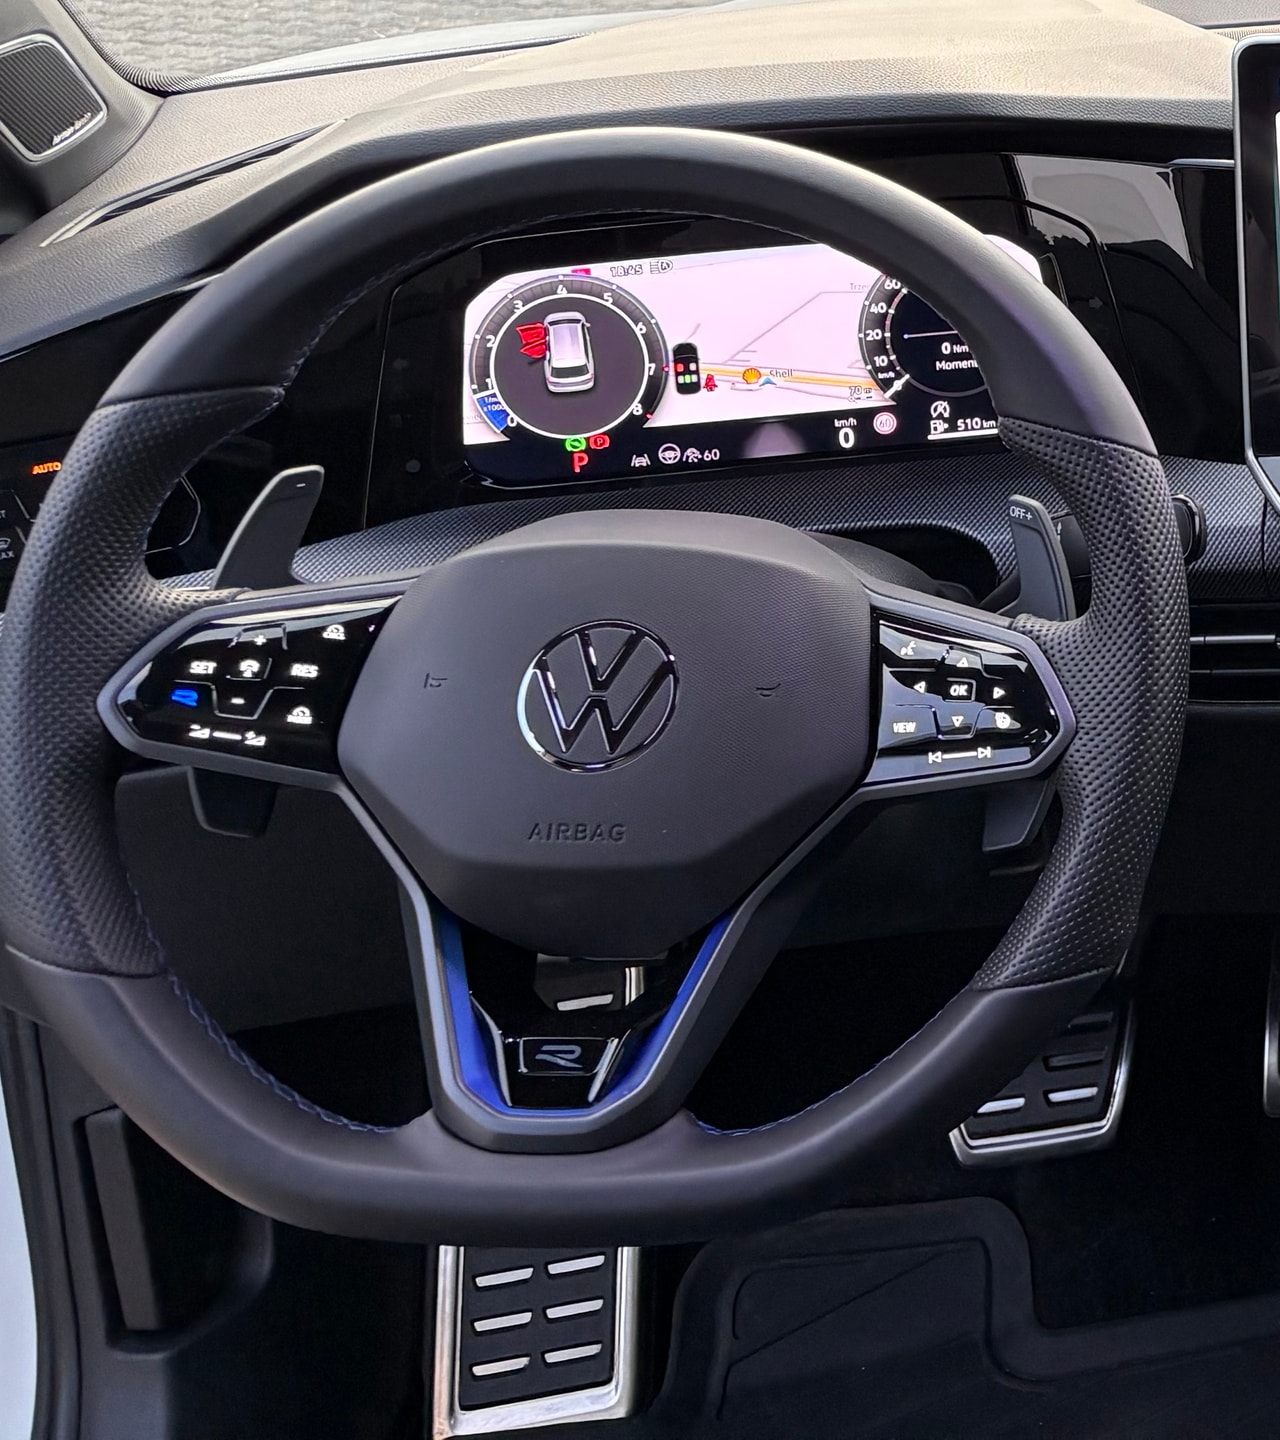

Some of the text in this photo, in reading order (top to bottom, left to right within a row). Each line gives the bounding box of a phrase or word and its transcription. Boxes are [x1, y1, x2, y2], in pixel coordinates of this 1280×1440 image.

[610, 263, 643, 277] 18:45
[557, 284, 568, 296] 4
[603, 292, 614, 304] 5
[513, 299, 524, 312] 3
[870, 302, 887, 314] 40
[636, 322, 647, 334] 6
[866, 328, 882, 340] 20
[486, 334, 496, 347] 2
[941, 342, 969, 355] 0 Nm
[874, 355, 888, 367] 10
[648, 363, 656, 376] 7
[770, 368, 793, 379] Shell
[849, 386, 862, 396] 70
[631, 403, 642, 416] 8
[506, 414, 517, 427] 0
[834, 418, 857, 427] km/h
[879, 417, 892, 428] 60
[957, 418, 981, 430] 510
[838, 427, 855, 449] 0
[703, 449, 720, 460] 60
[31, 461, 61, 474] AUTO
[573, 451, 588, 473] P
[189, 661, 217, 675] SET
[290, 663, 319, 678] RES
[949, 684, 968, 696] OK
[892, 722, 916, 734] VIEW
[527, 823, 627, 843] AIRBAG
